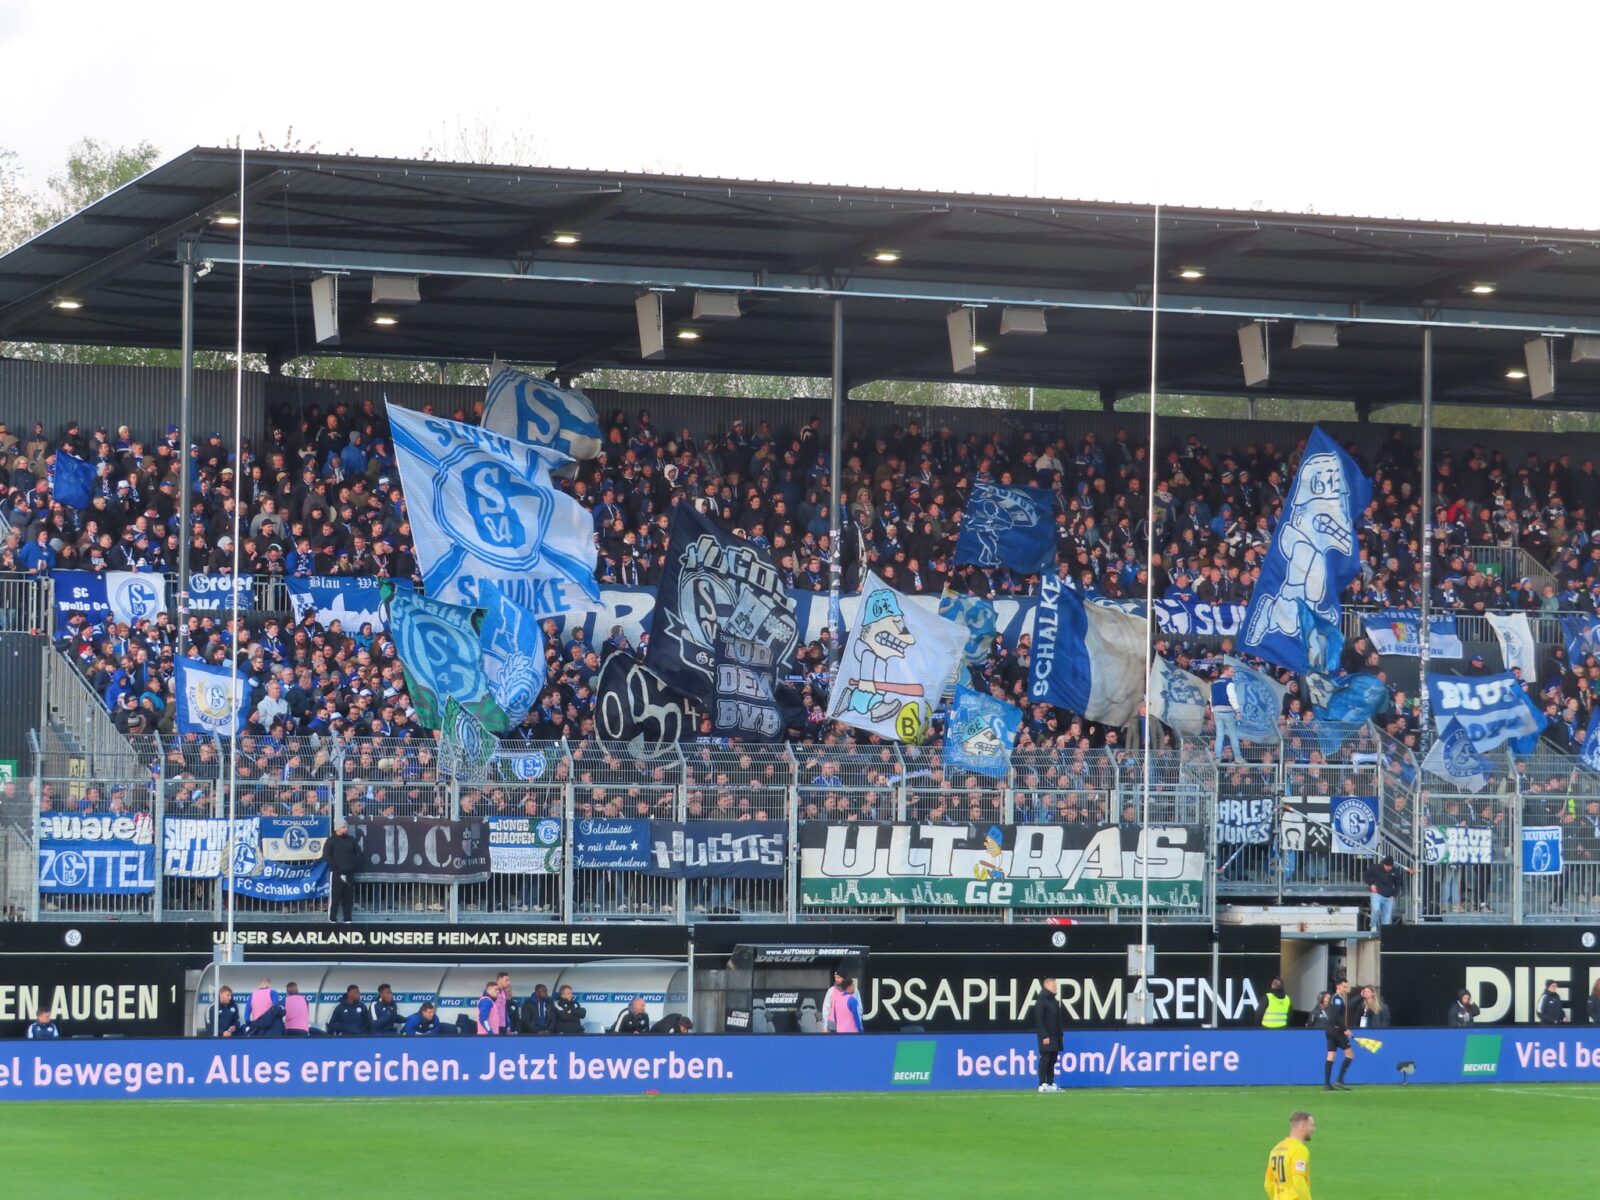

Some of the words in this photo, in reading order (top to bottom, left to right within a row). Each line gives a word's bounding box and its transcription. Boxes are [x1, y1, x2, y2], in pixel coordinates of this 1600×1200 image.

[1032, 575, 1060, 697] SCHALKE
[715, 699, 780, 736] BVB
[651, 830, 784, 869] HUGOS
[1446, 828, 1491, 847] BLUE
[163, 850, 222, 876] CLUB
[237, 879, 252, 889] FC
[255, 883, 300, 895] Schalke
[272, 931, 366, 946] SAARLAND.
[370, 932, 434, 946] UNSERE
[438, 932, 501, 946] HEIMAT.
[505, 932, 568, 946] UNSERE
[571, 933, 602, 946] ELV.
[51, 985, 158, 1020] AUGEN
[1463, 1063, 1496, 1071] BECHTLE
[1515, 1042, 1567, 1068] Viel
[34, 1056, 195, 1092] bewegen.
[206, 1055, 290, 1084] Alles
[301, 1053, 469, 1083] erreichen.
[480, 1052, 558, 1081] Jetzt
[569, 1051, 734, 1080] bewerben.
[894, 1072, 930, 1080] BECHTLE
